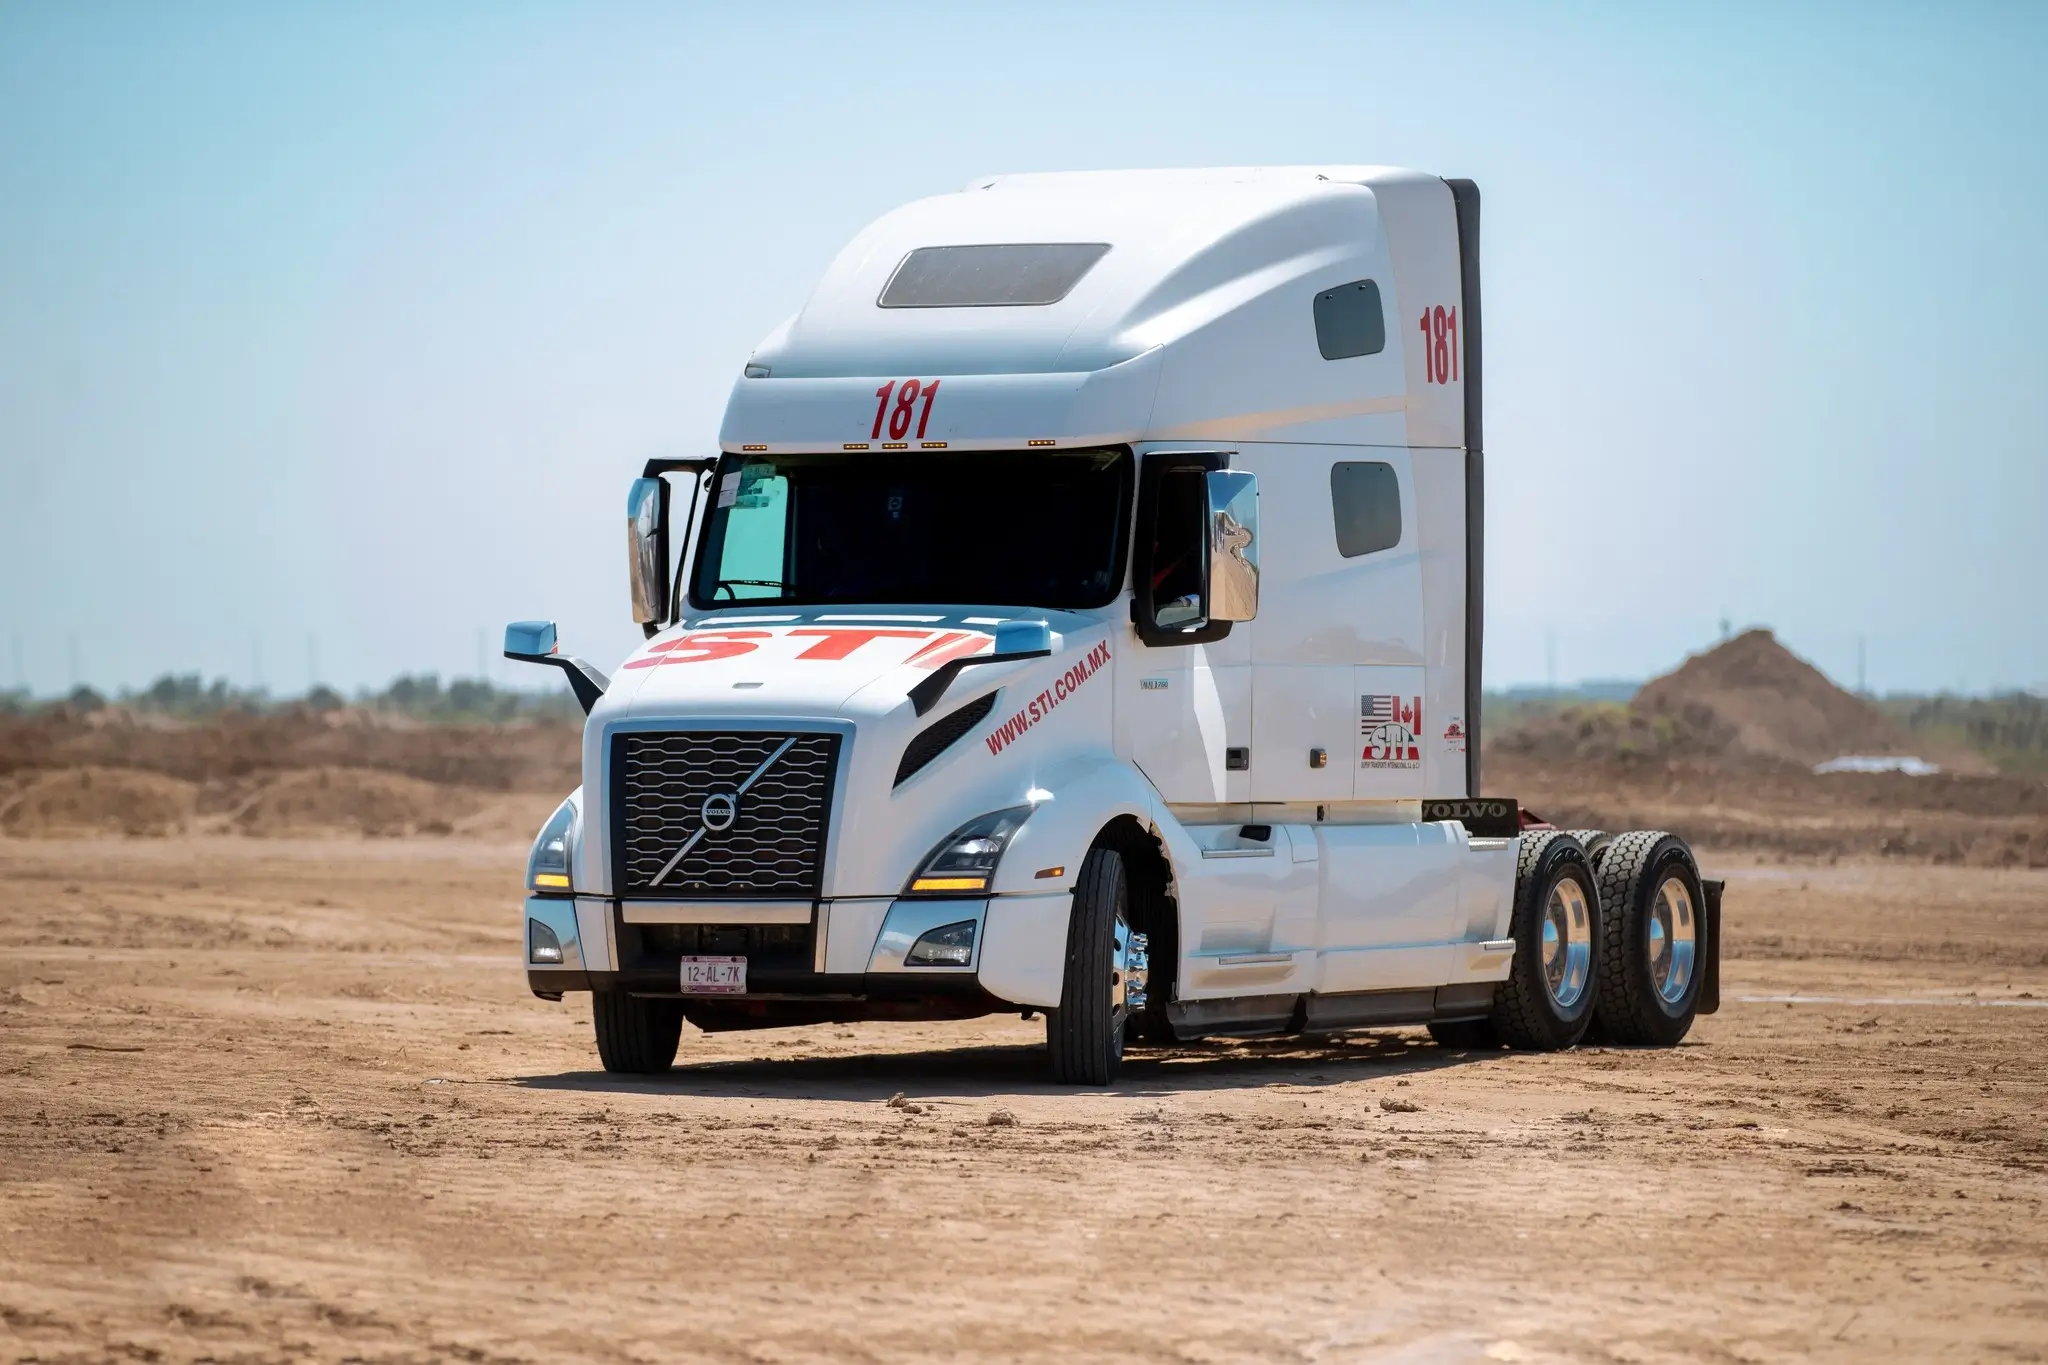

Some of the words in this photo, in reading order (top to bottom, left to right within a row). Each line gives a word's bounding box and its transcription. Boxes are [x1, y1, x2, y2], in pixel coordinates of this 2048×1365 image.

[1420, 305, 1458, 385] 181
[871, 379, 941, 440] 181
[623, 629, 994, 671] STI
[985, 640, 1111, 756] WWW.STI.COM.MX
[1371, 723, 1410, 760] STI
[688, 966, 740, 982] 12-AL-7K
